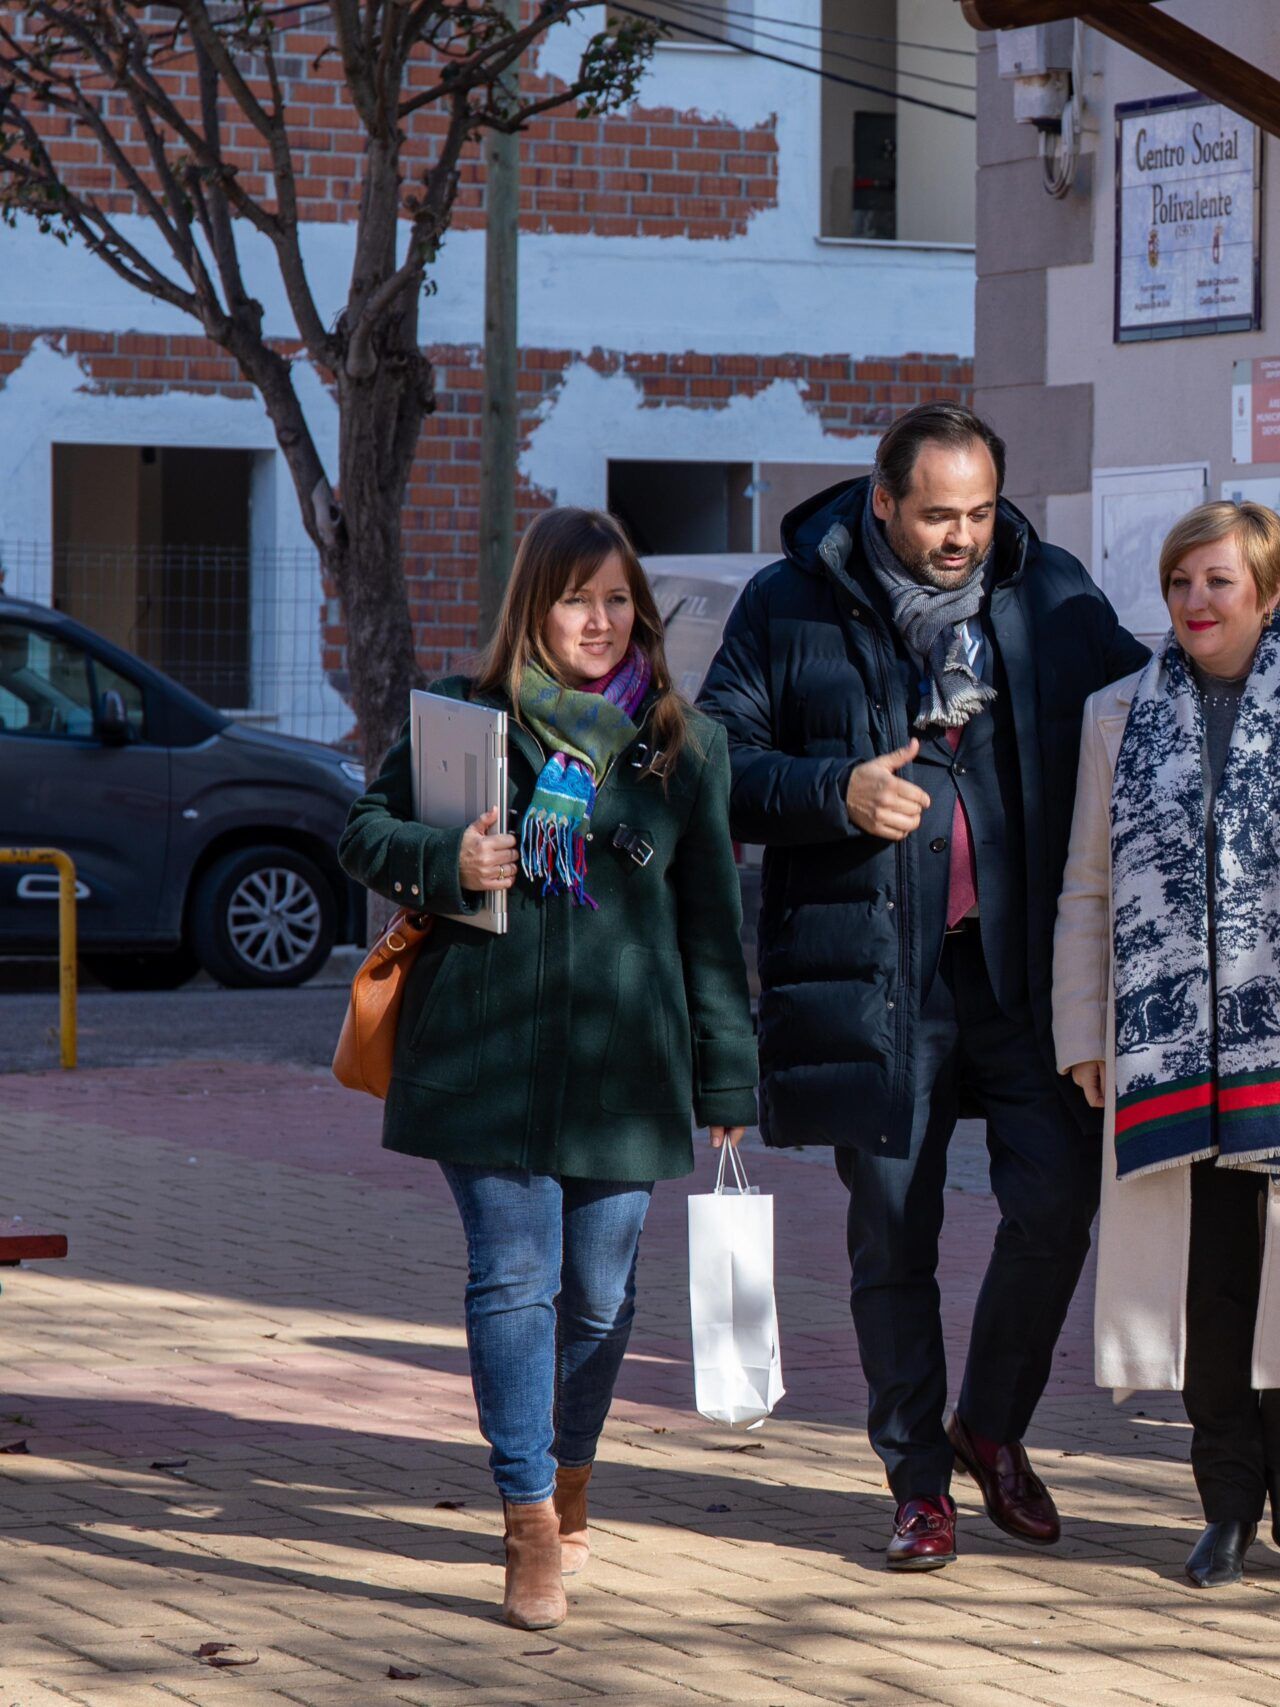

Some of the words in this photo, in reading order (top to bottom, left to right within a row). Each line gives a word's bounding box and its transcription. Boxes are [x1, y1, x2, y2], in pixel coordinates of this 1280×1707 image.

[1136, 128, 1184, 172] Centro
[1192, 122, 1238, 166] Social
[1152, 184, 1232, 226] Polivalente
